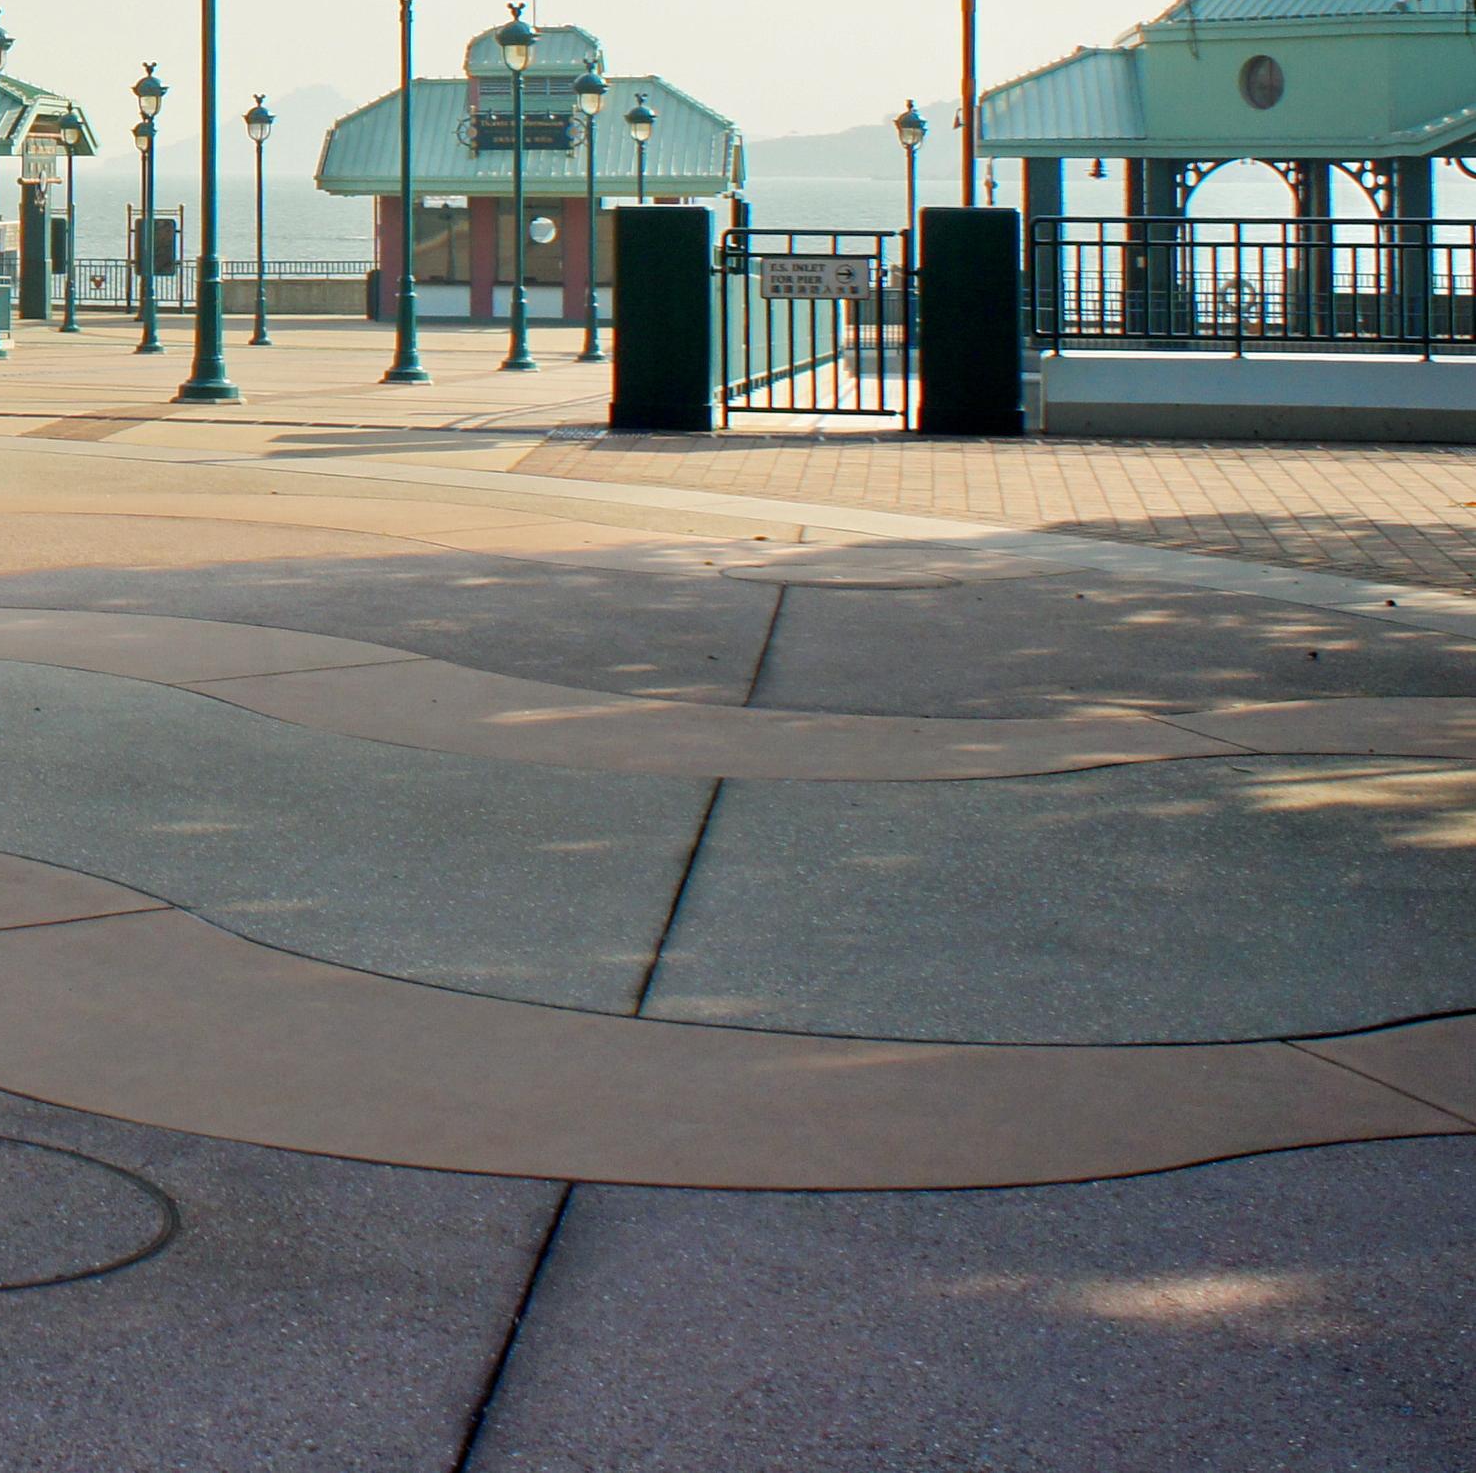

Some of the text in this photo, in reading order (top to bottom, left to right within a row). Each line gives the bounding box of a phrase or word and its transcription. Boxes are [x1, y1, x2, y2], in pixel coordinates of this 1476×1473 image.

[792, 263, 826, 273] INLET
[769, 275, 823, 284] FOR PIER
